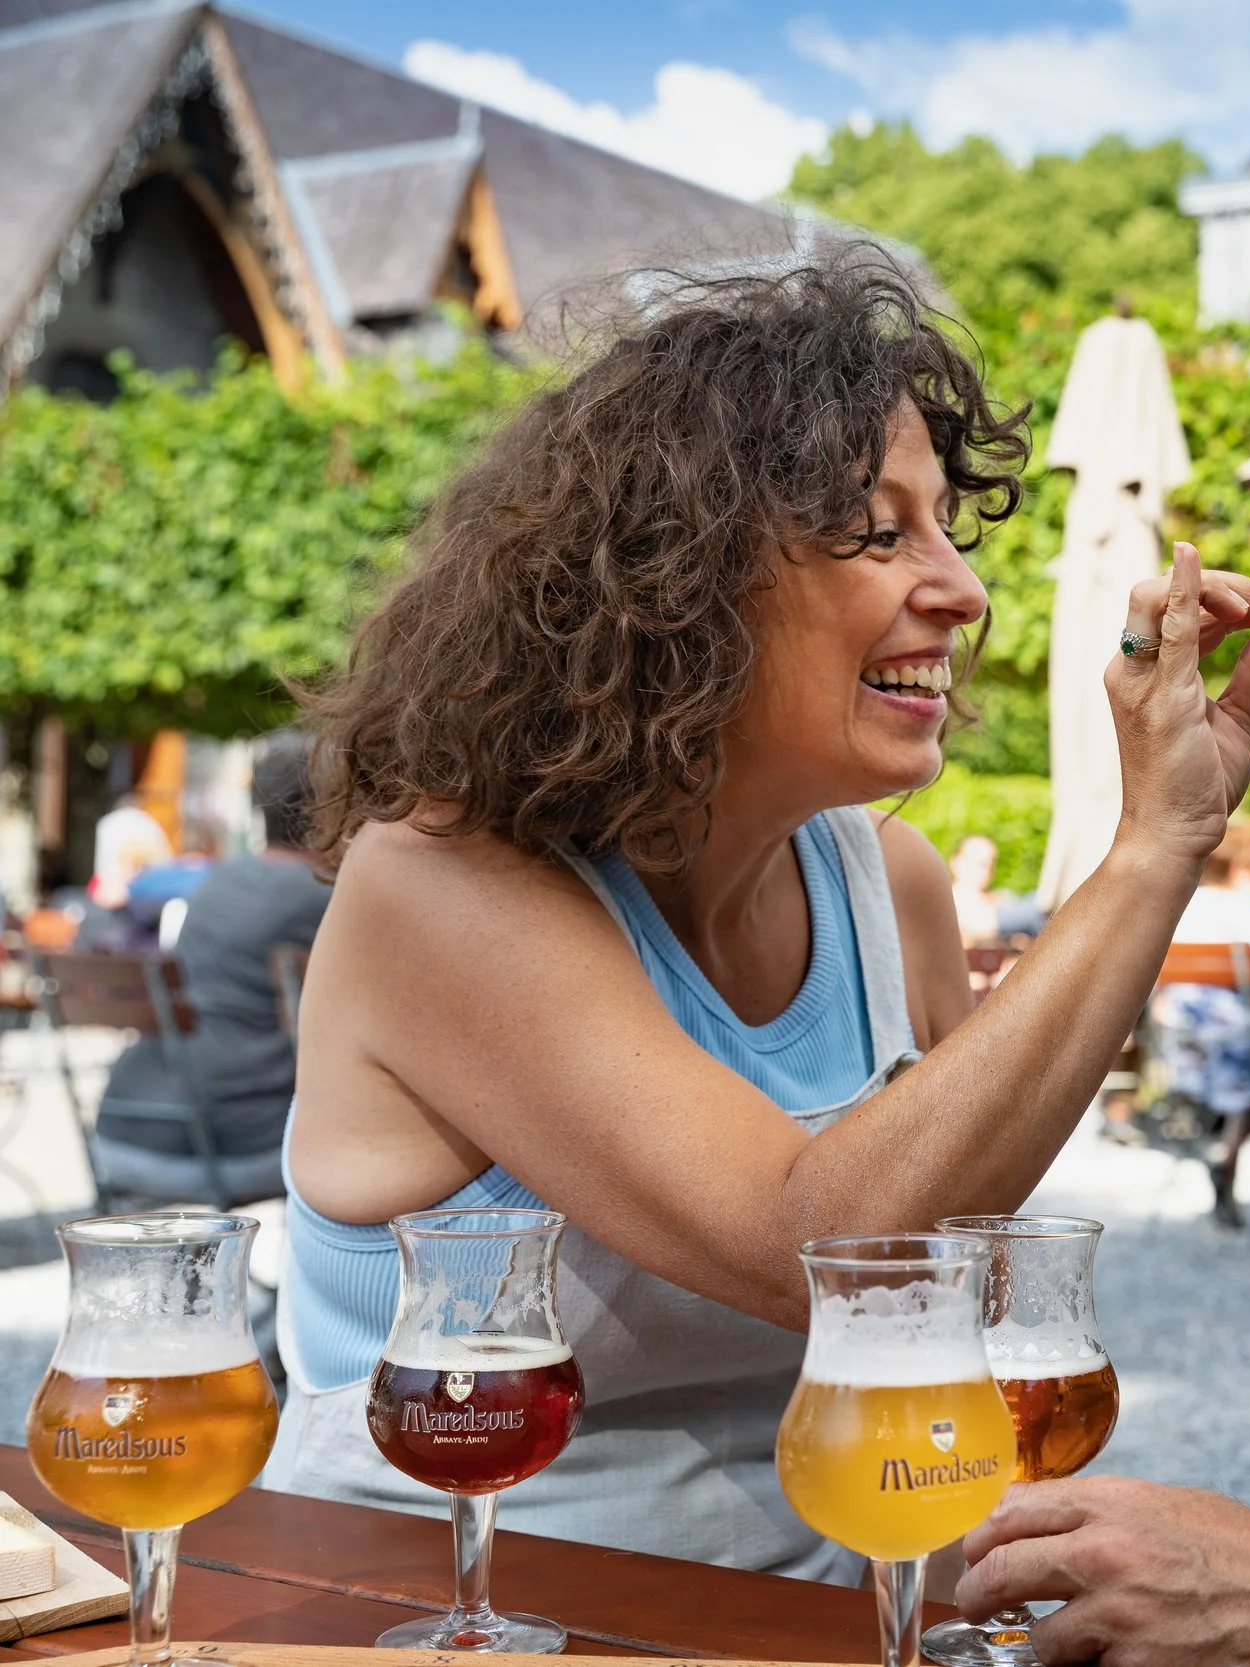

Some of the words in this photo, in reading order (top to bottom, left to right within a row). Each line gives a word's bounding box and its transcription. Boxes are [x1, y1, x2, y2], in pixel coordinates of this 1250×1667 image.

[400, 1400, 524, 1433] Maredsous
[54, 1426, 187, 1461] Maredsous
[879, 1452, 999, 1492] Maredsous
